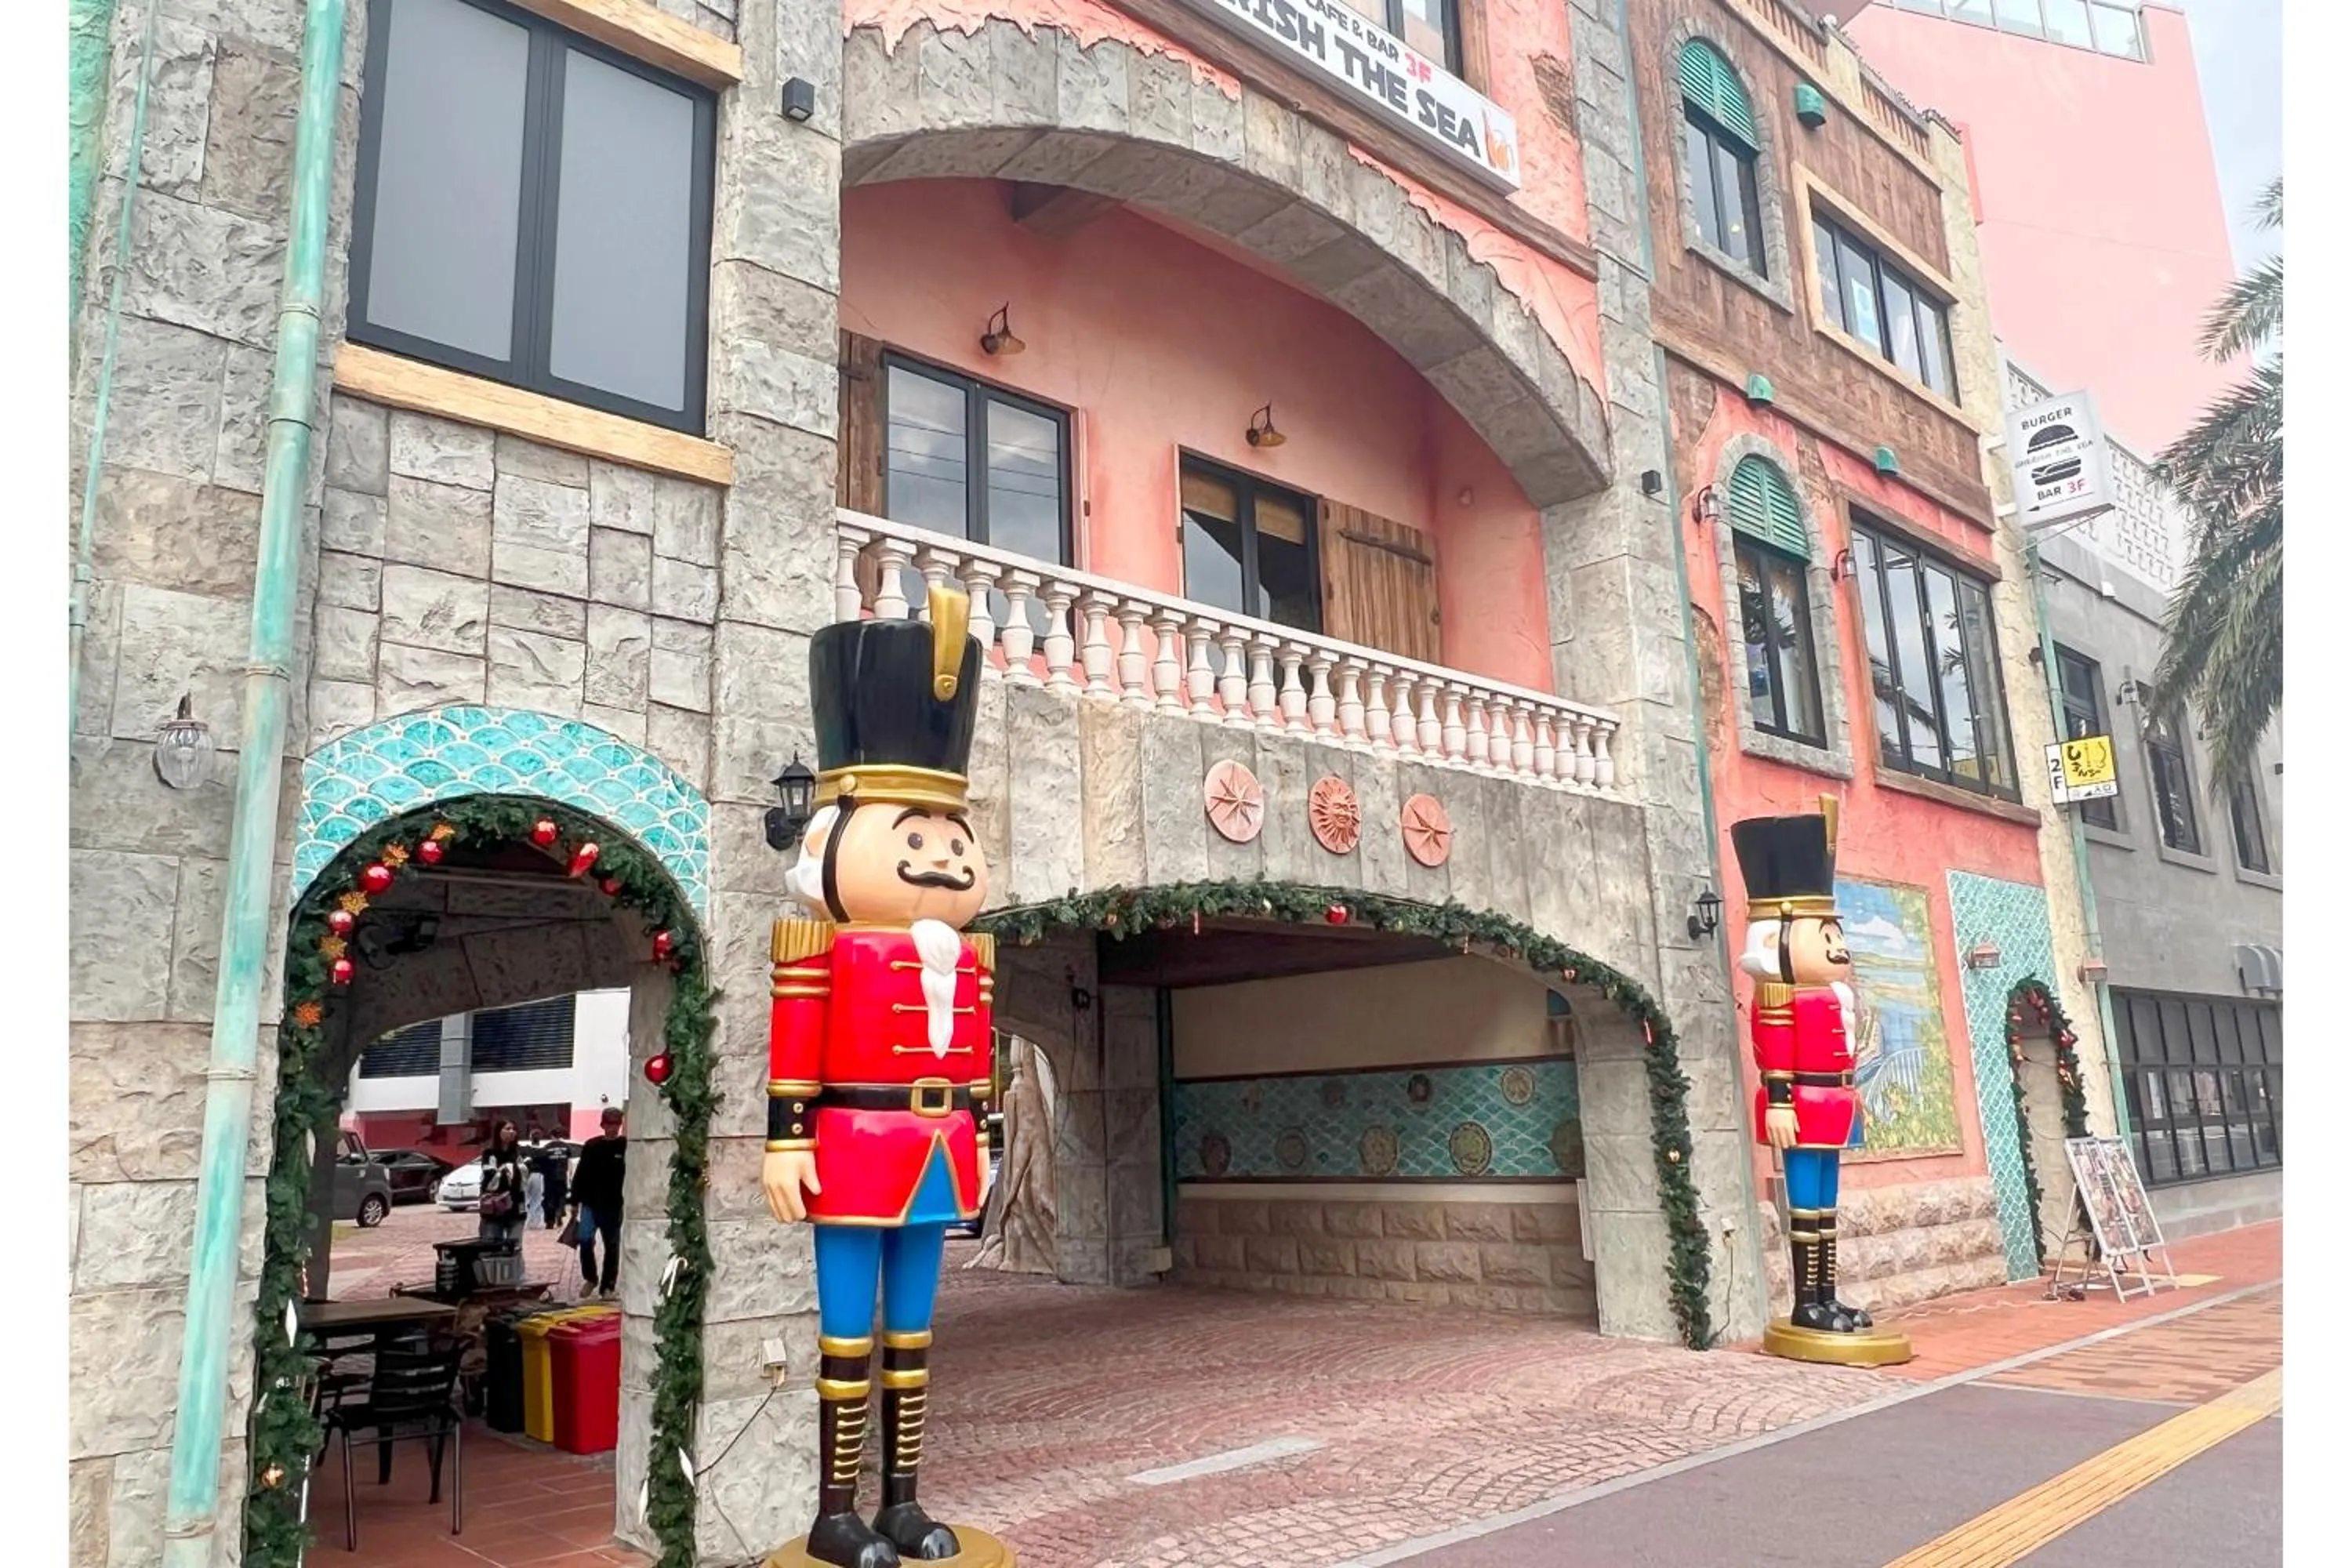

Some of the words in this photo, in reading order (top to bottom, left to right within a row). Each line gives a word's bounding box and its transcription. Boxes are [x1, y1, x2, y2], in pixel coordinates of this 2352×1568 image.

[1352, 19, 1364, 40] &
[1367, 31, 1399, 63] BAR
[1404, 52, 1432, 83] 3F
[1334, 34, 1408, 114] THE
[1416, 88, 1481, 158] SEA
[2021, 407, 2072, 430] BURGER
[2038, 486, 2062, 500] BAR
[2067, 478, 2087, 494] 3F
[2050, 758, 2064, 789] 2F
